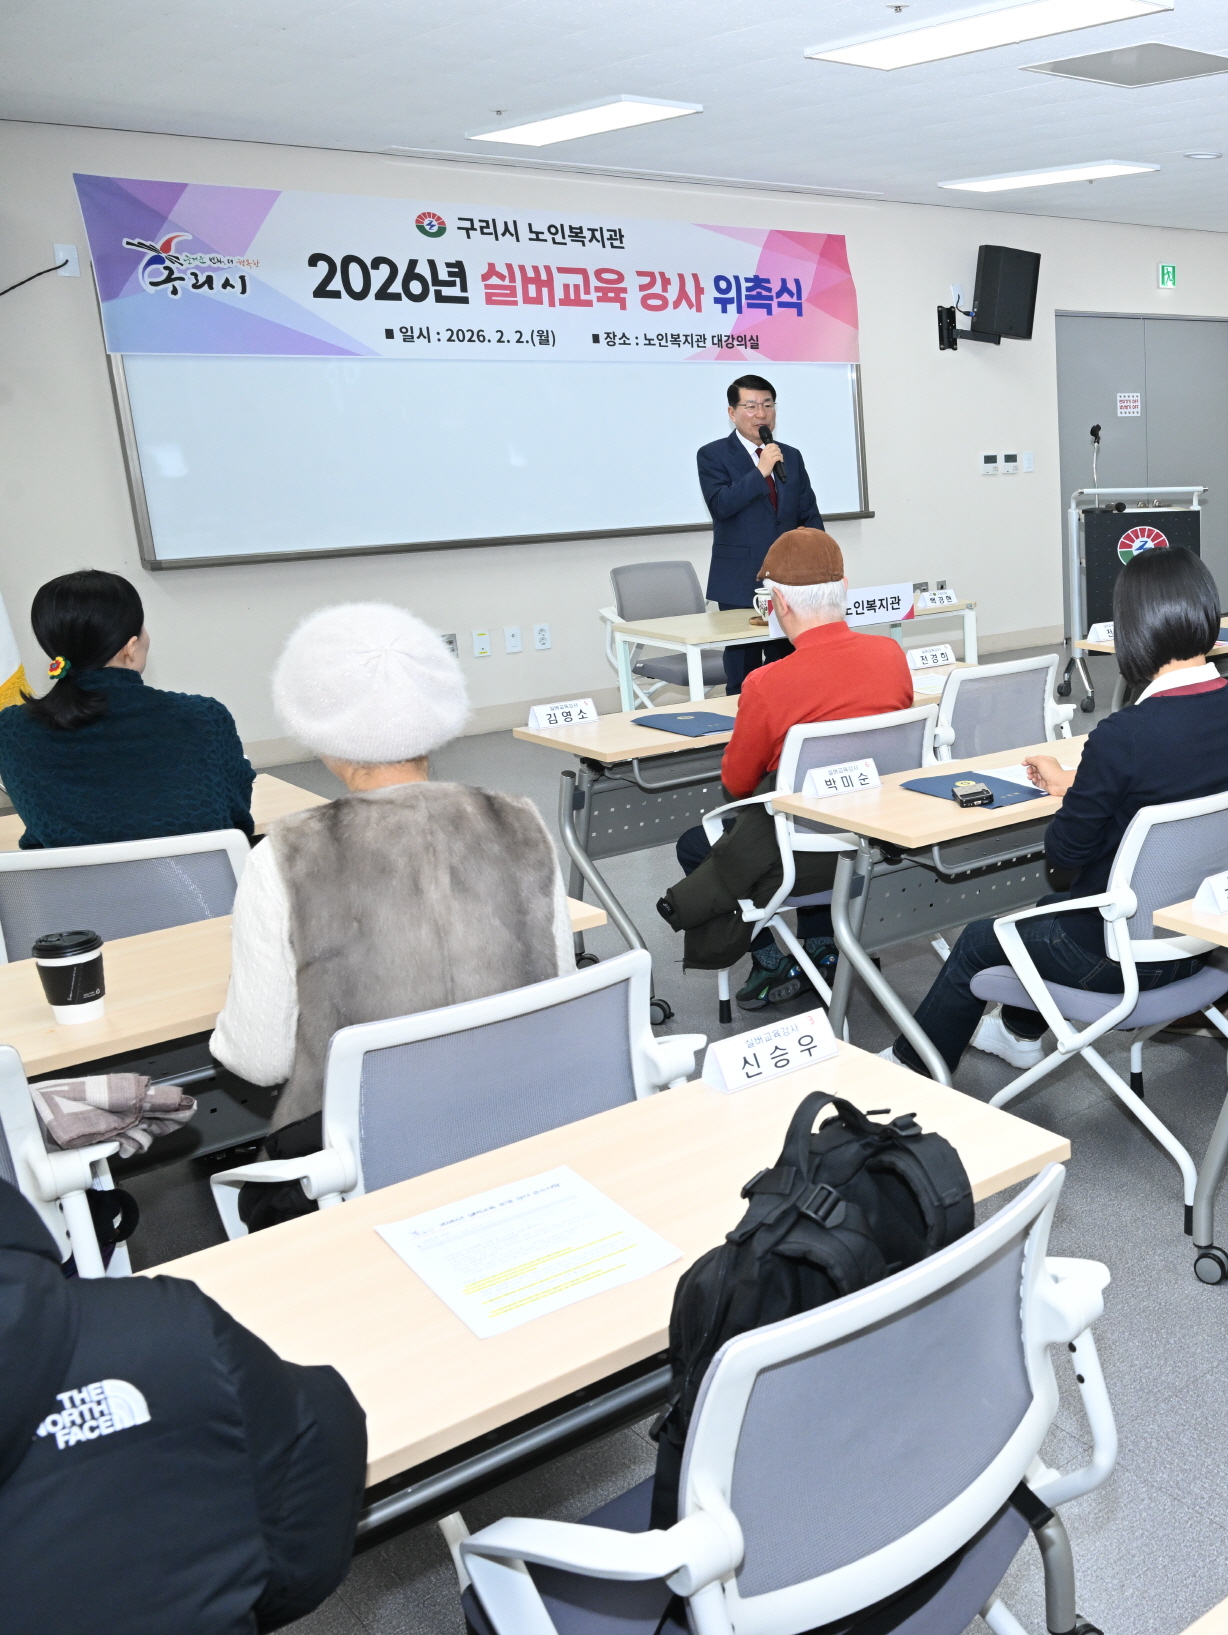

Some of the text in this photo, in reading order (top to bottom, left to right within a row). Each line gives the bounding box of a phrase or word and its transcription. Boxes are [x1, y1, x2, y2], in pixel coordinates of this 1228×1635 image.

[457, 217, 625, 249] 구리시 노인복지관
[149, 266, 246, 296] 구리시
[308, 252, 803, 316] 2026년 실버교육 강사 위촉식
[399, 326, 432, 344] 일시
[446, 329, 490, 344] 2026.
[604, 331, 632, 347] 장소
[643, 333, 707, 349] 노인복지관
[712, 334, 760, 350] 대강의실
[546, 709, 588, 724] 김영소
[825, 773, 870, 790] 박미순
[745, 1023, 799, 1048] 실버교육강사
[742, 1034, 818, 1079] 신승우
[56, 1382, 104, 1409] THE
[55, 1414, 114, 1450] FACE
